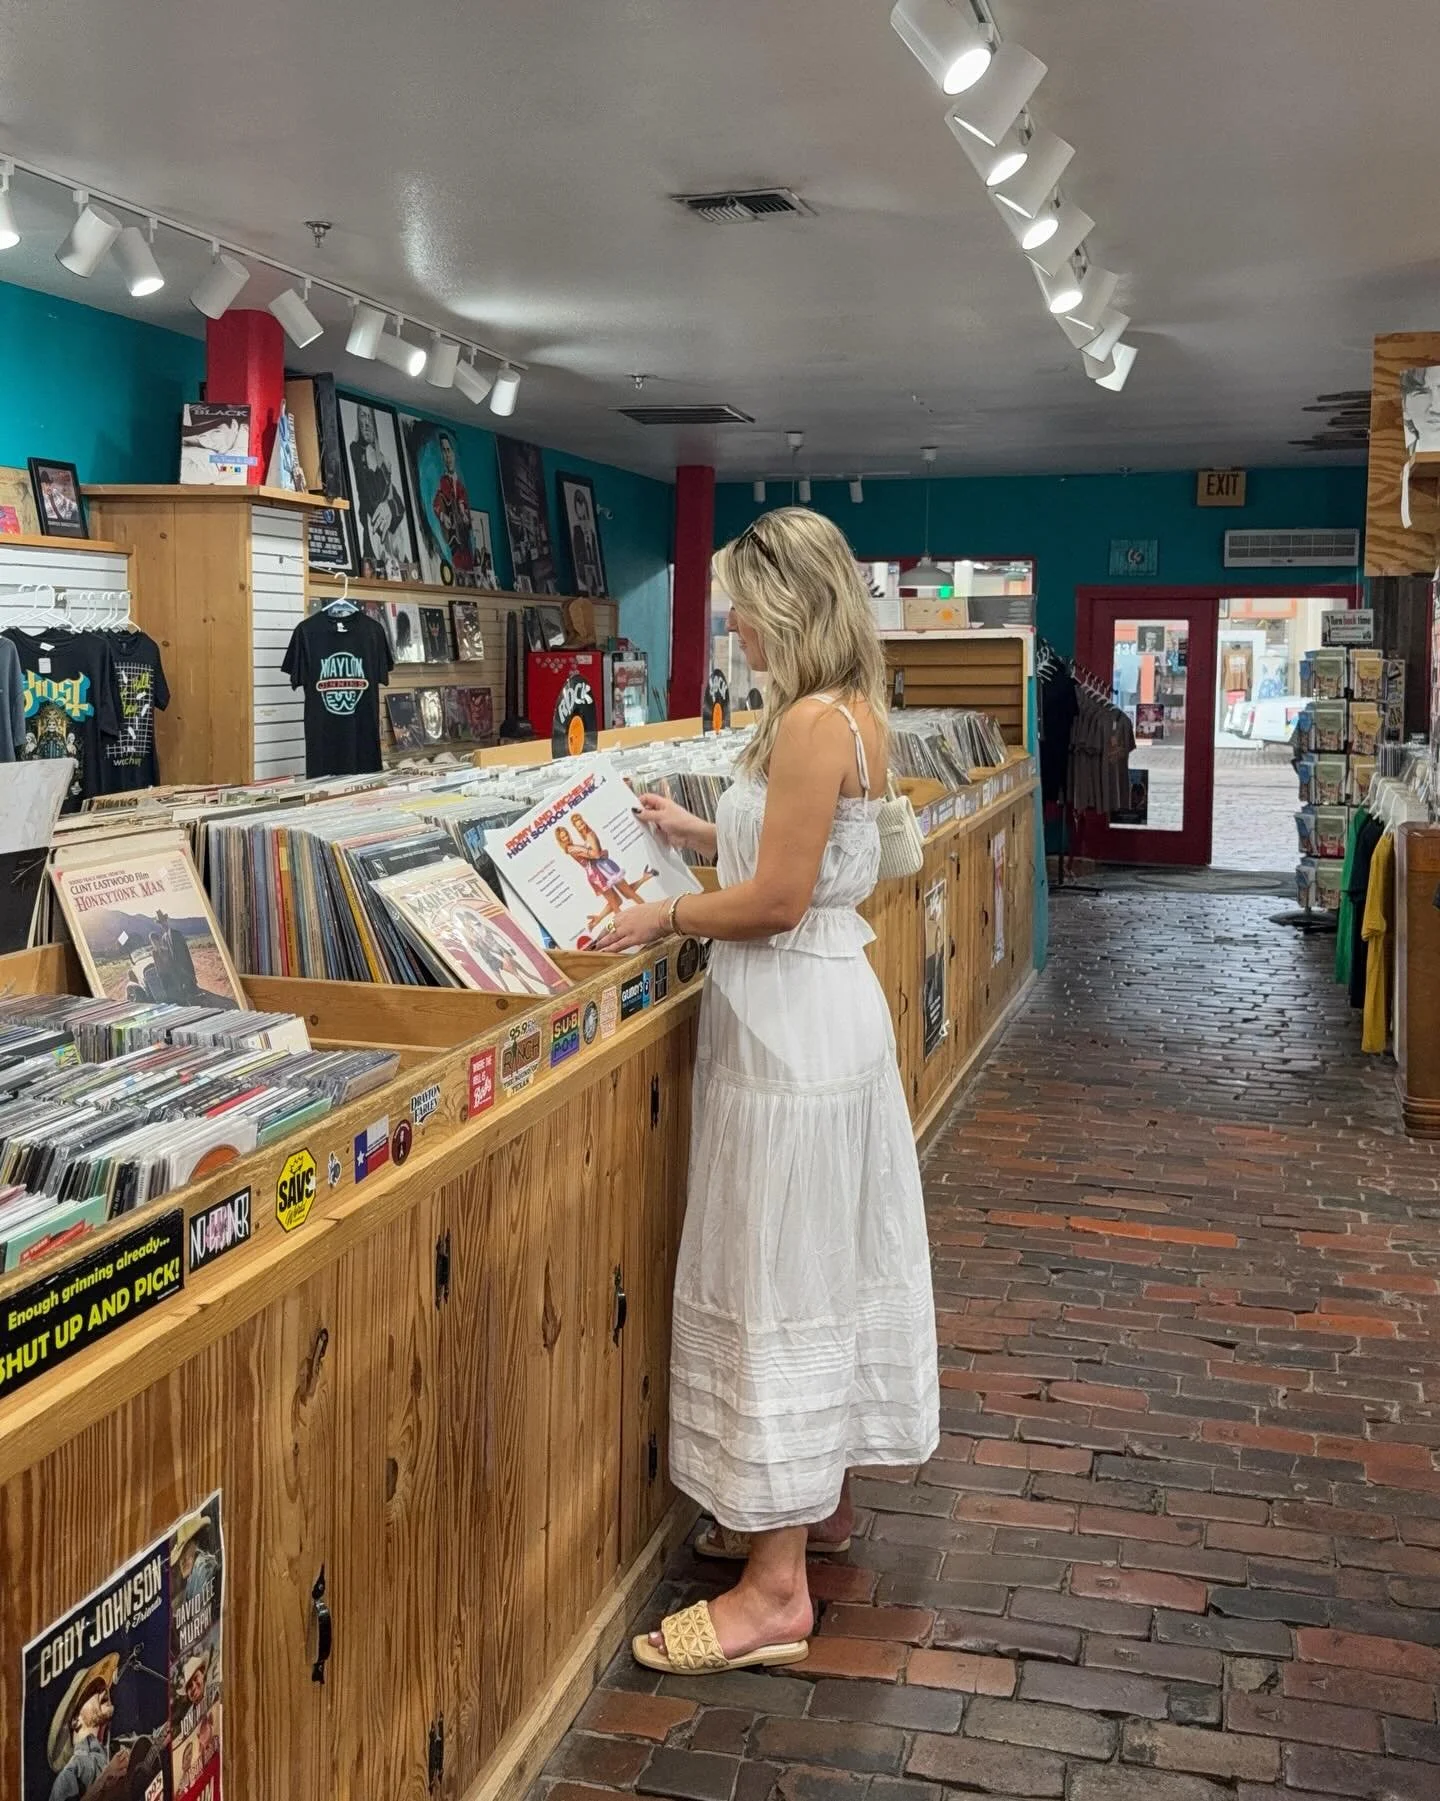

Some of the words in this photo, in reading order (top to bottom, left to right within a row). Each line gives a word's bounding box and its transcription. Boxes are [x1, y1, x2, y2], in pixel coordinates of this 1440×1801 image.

[194, 408, 248, 417] BLACK
[1207, 474, 1239, 497] EXIT
[321, 657, 363, 678] WAYLON
[505, 825, 531, 850] ROMY
[534, 809, 553, 828] AND
[507, 837, 532, 859] HIGH
[531, 808, 569, 840] SCHOOL
[568, 776, 606, 810] REUNI
[70, 883, 92, 896] CLINT
[94, 873, 135, 892] EASTWOOD
[135, 872, 150, 882] Film
[140, 880, 166, 898] MAN
[509, 1022, 528, 1038] 95.9
[554, 1013, 578, 1038] SUB
[554, 1034, 578, 1054] POP
[8, 1289, 59, 1331] Enough
[62, 1263, 113, 1304] grinning
[116, 1236, 170, 1271] already...
[55, 1314, 83, 1349] UP
[87, 1287, 131, 1332] AND
[134, 1256, 180, 1303] PICK!
[175, 1593, 201, 1630] DAVID
[202, 1576, 216, 1606] LEE
[39, 1615, 87, 1689] CODY
[89, 1554, 162, 1649] JOHNSON
[180, 1601, 213, 1650] MURPHY
